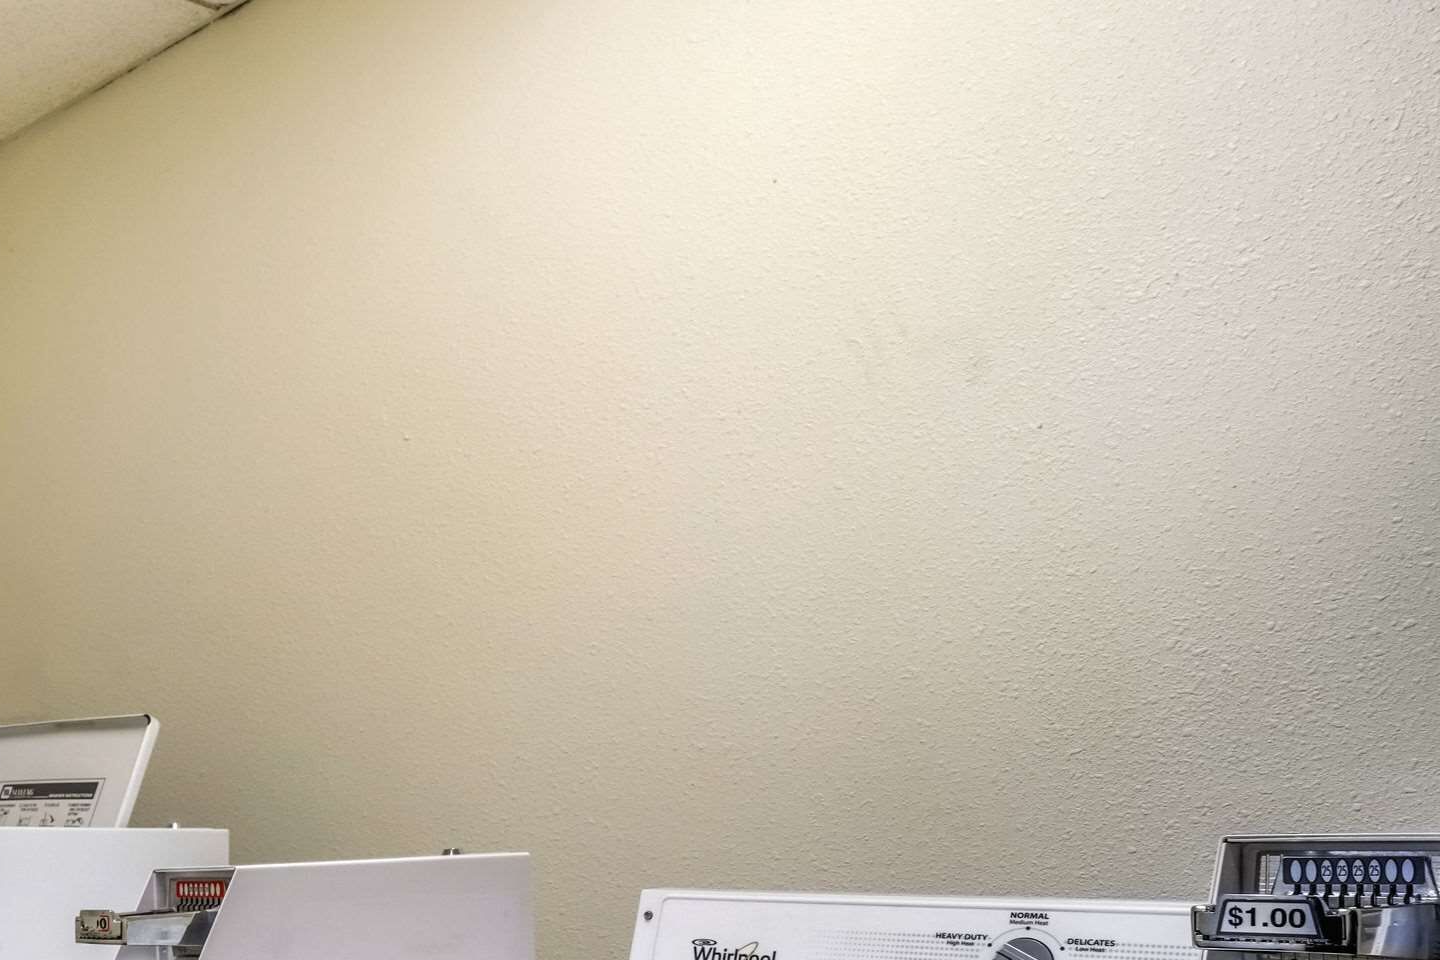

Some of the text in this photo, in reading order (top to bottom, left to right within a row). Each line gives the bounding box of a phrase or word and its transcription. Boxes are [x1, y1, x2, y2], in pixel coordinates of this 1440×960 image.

[1321, 865, 1380, 877] 25 25 25 25
[1010, 912, 1050, 920] NORMAL
[1228, 906, 1306, 928] $1.00
[935, 932, 988, 941] HEAVY DUTY
[1067, 938, 1116, 947] DELICATES
